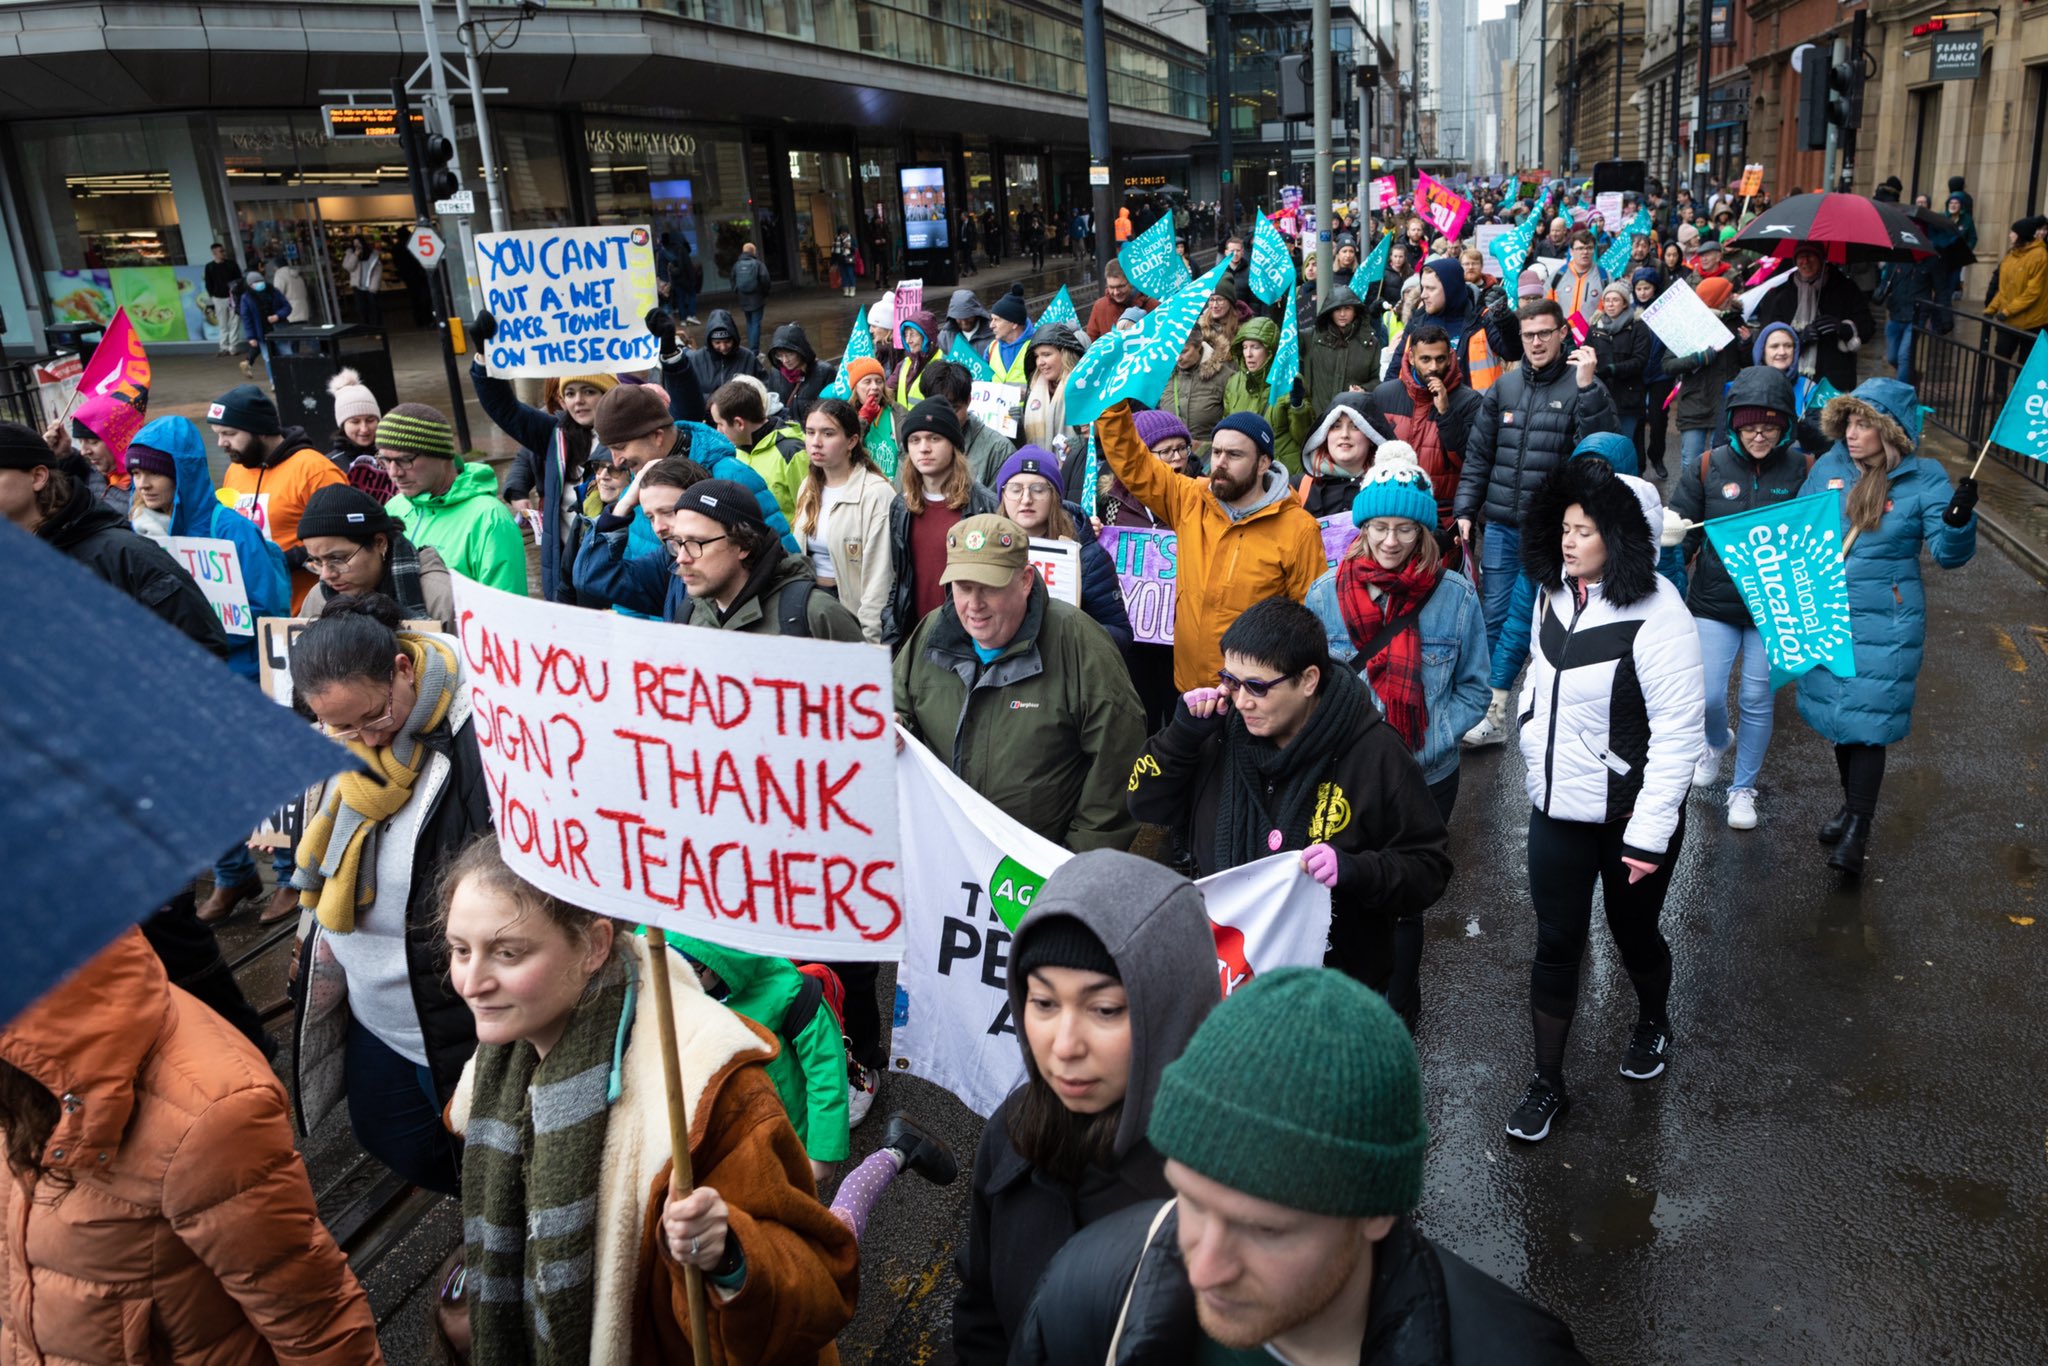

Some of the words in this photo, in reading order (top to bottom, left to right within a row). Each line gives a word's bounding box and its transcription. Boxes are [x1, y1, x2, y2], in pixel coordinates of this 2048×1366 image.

[1936, 42, 1978, 53] FRANCO
[1936, 52, 1976, 63] MANCA
[437, 203, 471, 212] STREET
[418, 235, 435, 257] 5
[478, 238, 534, 282] YOU
[539, 236, 630, 280] CAN'T
[488, 284, 528, 316] PUT
[540, 286, 563, 312] A
[569, 278, 615, 309] WET
[488, 315, 548, 346] APER
[551, 306, 630, 336] TOWEL
[492, 346, 526, 370] ON
[180, 549, 233, 585] JUST
[1115, 531, 1177, 580] IT'S
[1741, 575, 1767, 627] union
[1748, 525, 1807, 671] education
[1789, 556, 1827, 636] national
[460, 609, 521, 688] CAN
[530, 642, 611, 703] YOU
[632, 660, 753, 731] READ
[753, 676, 887, 743] THIS
[471, 686, 586, 798] SIGN?
[613, 728, 874, 836] THANK
[482, 758, 602, 889] YOUR
[595, 807, 903, 942] TEACHERS
